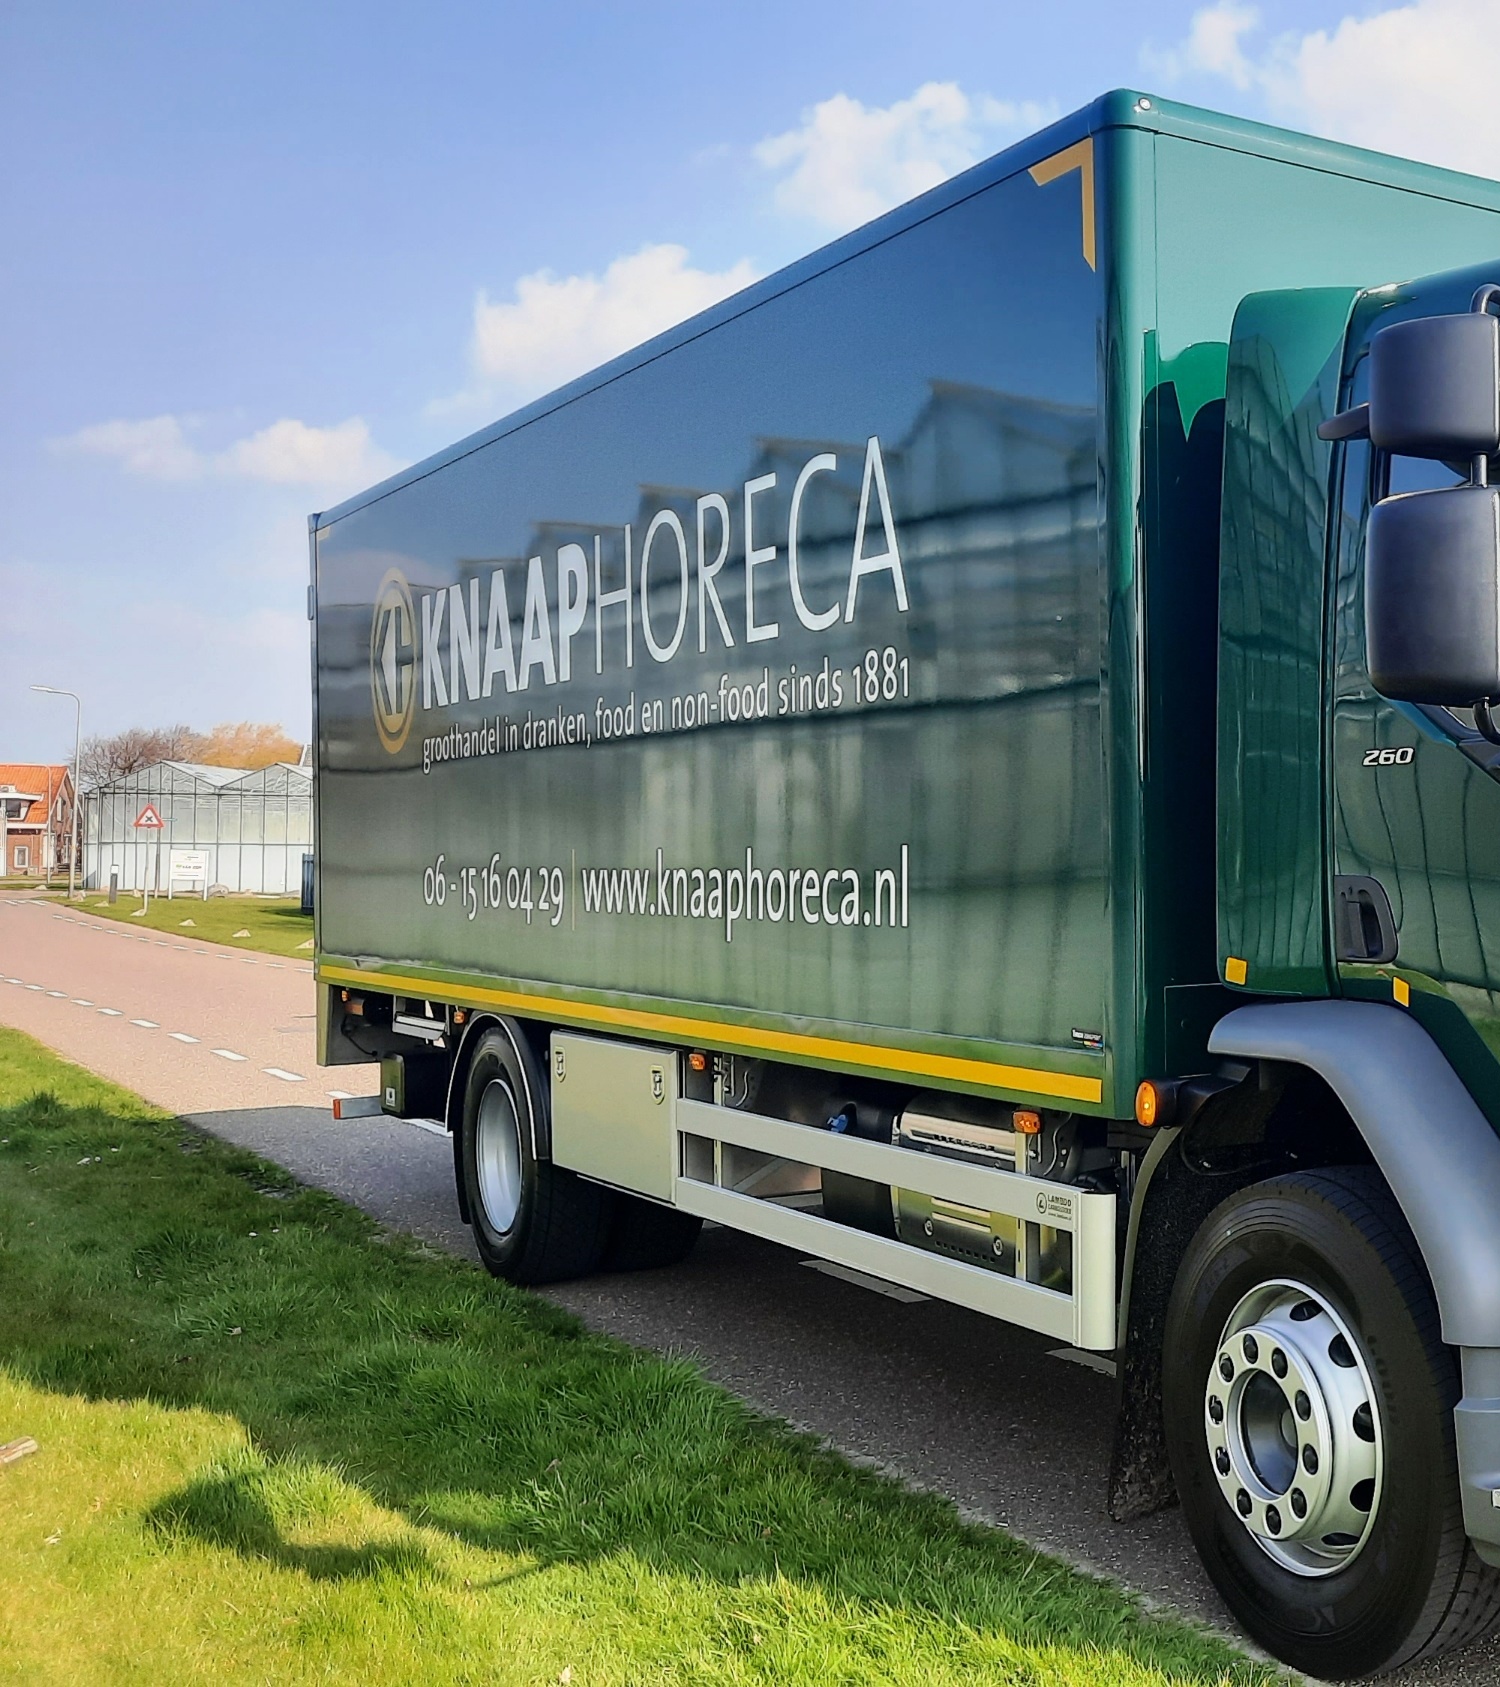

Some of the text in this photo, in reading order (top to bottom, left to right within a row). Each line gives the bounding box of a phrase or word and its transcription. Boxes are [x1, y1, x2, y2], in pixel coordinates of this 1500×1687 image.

[420, 435, 909, 710] KNAAPHORECA
[422, 645, 911, 774] groothandel in dranken, food en non-food sinds 1881
[1362, 747, 1414, 766] 260
[423, 854, 446, 906] 06
[459, 867, 478, 921] 15
[481, 853, 501, 909] 16
[506, 867, 534, 924] 04
[538, 866, 564, 926] 29
[581, 844, 910, 942] www.knaaphoreca.nl
